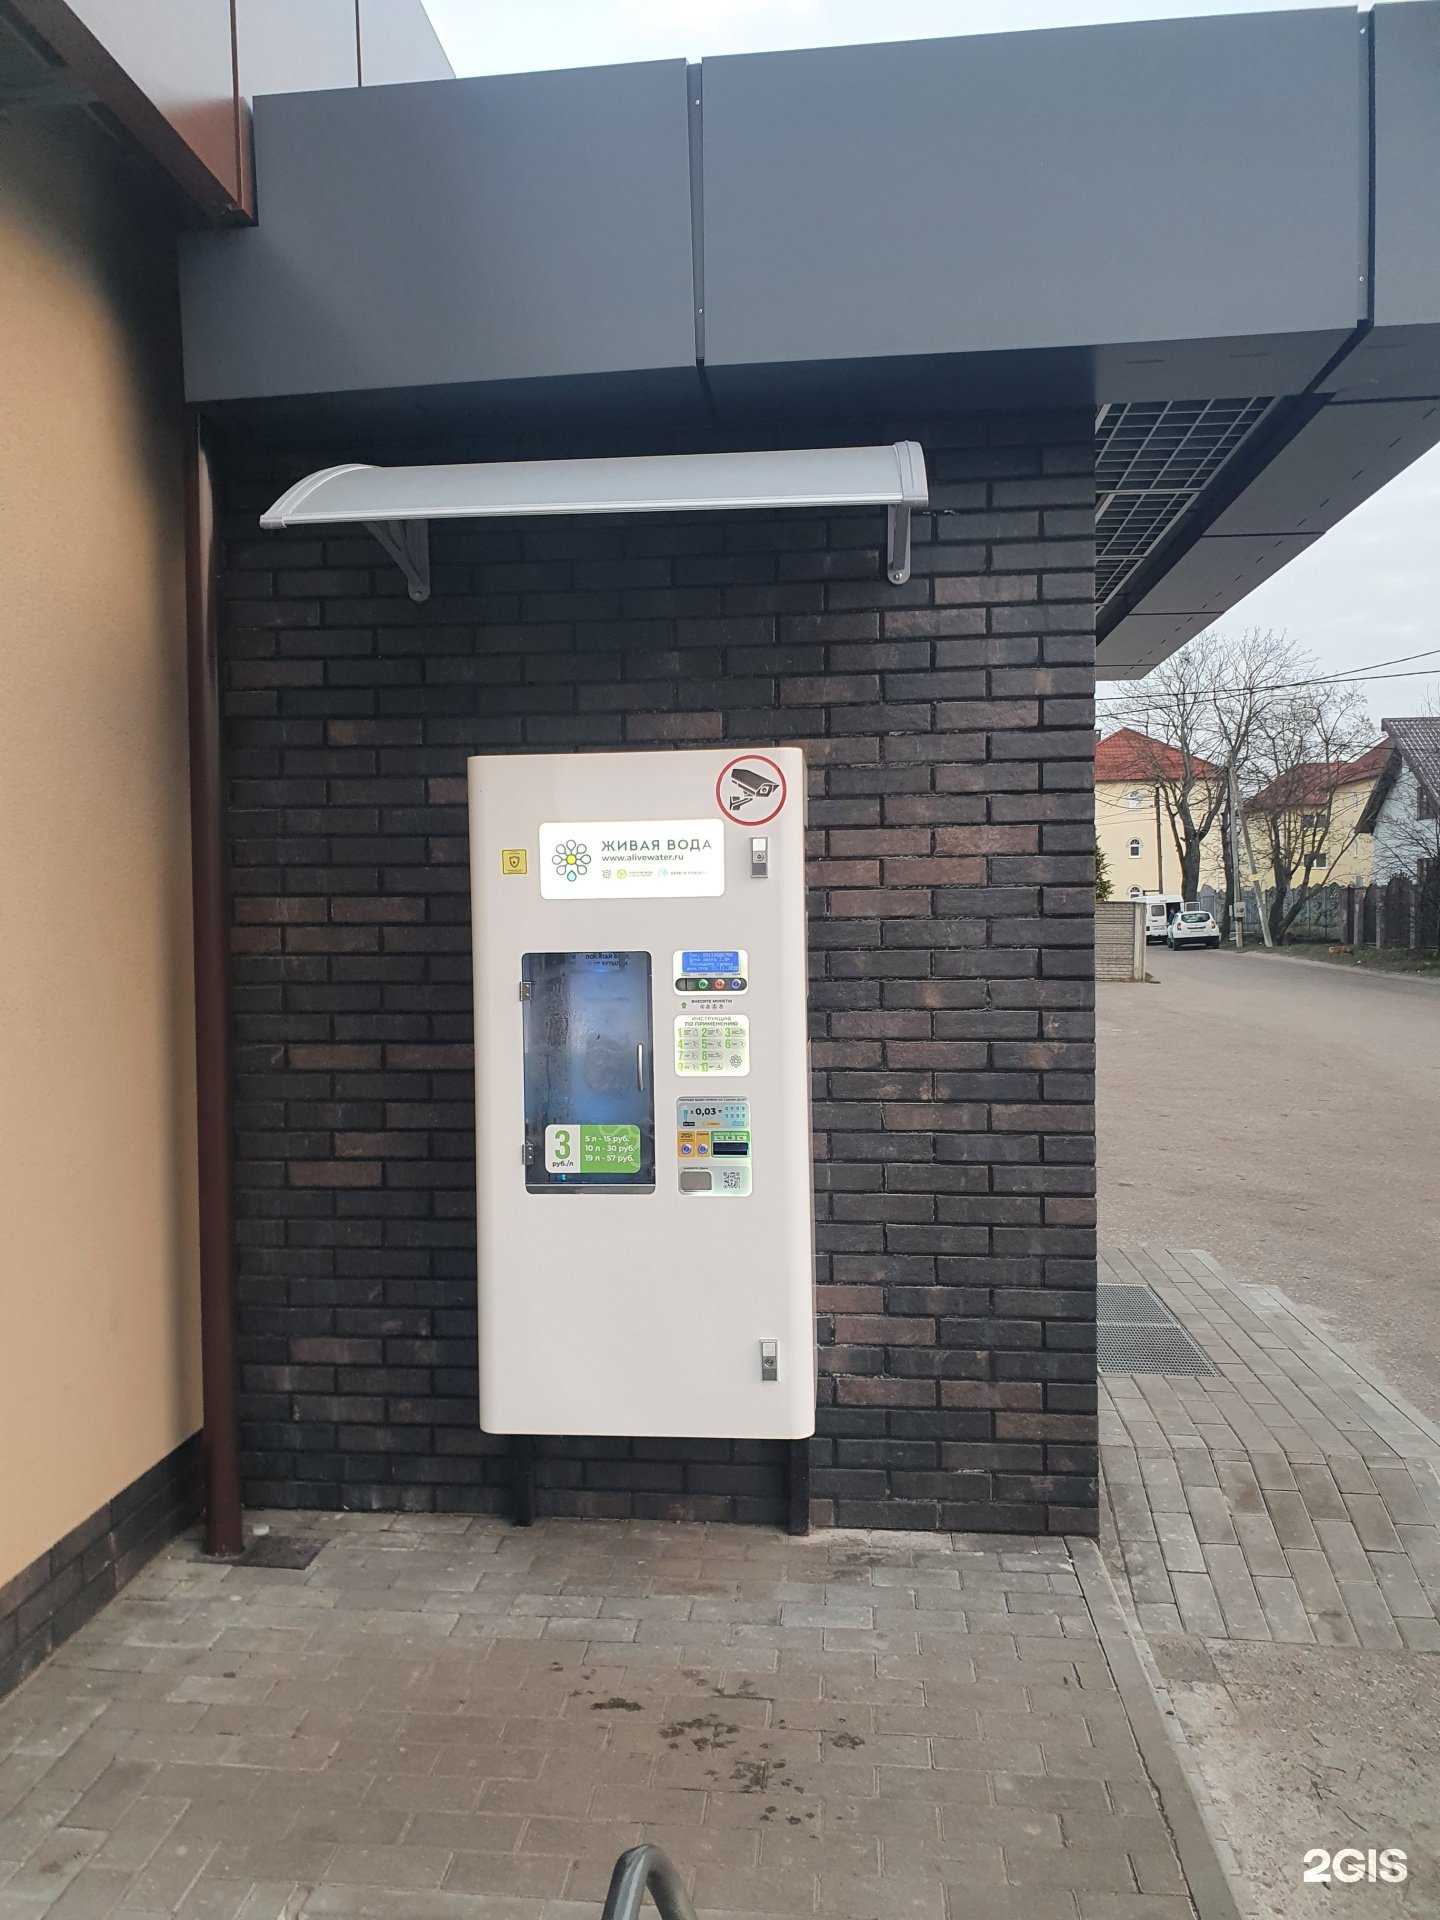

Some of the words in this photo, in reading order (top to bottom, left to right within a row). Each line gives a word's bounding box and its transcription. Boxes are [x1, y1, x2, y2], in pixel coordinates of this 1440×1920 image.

[601, 840, 660, 851] ЖИВАЯ
[667, 839, 712, 852] ВОДА
[601, 854, 684, 862] www.alivewater.ru
[695, 1107, 716, 1118] 0,03
[613, 1135, 630, 1144] руб.
[554, 1130, 571, 1159] 3
[618, 1145, 634, 1154] руб.
[617, 1154, 634, 1163] руб.
[552, 1160, 574, 1168] руб./л
